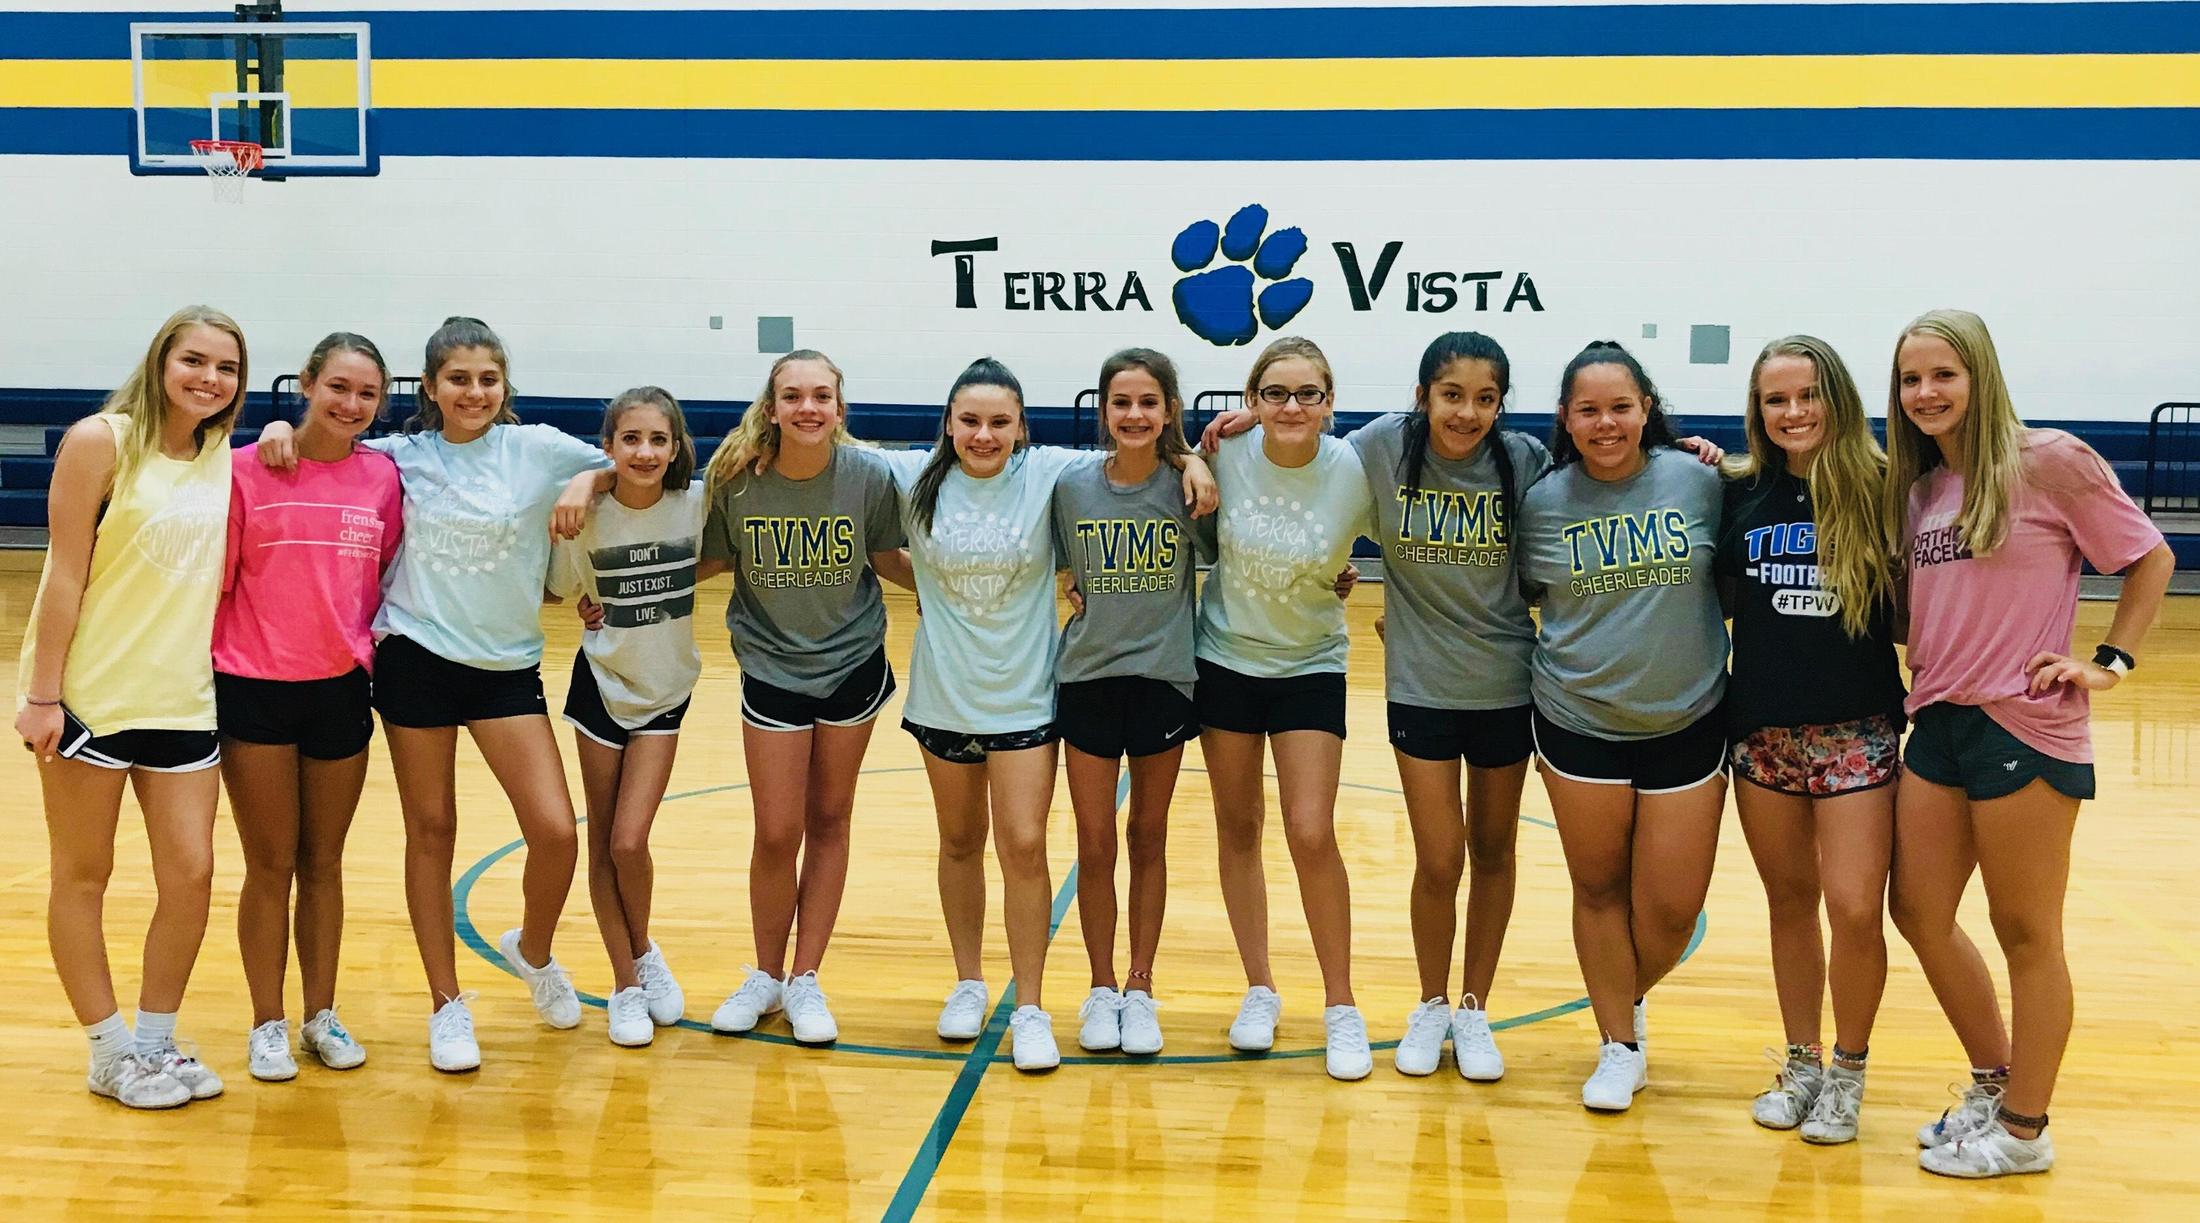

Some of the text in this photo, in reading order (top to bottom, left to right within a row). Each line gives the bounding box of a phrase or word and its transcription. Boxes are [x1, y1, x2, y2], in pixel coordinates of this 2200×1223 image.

[931, 236, 1546, 313] TERRA VISTA
[341, 509, 385, 531] frens
[1396, 485, 1507, 547] TVMS
[340, 526, 375, 544] cheer
[743, 516, 855, 569] TVMS
[944, 528, 1008, 553] TERRA
[1247, 513, 1306, 547] TERRA
[1562, 508, 1692, 576] TVMS
[1744, 522, 1818, 562] TIG
[1912, 526, 1953, 551] ORTH
[429, 529, 491, 560] VISTA
[629, 546, 660, 563] DON'T
[1076, 519, 1180, 573] TVMS
[1914, 544, 1953, 569] FACE
[618, 575, 674, 595] JUST EXIST.
[749, 568, 853, 589] CHEERLEADER
[948, 574, 1008, 601] VISTA
[1084, 573, 1176, 594] HEERLEADER
[1241, 559, 1297, 590] VISTA
[1569, 566, 1692, 598] CHEERLEADER
[1777, 594, 1835, 612] #TPW
